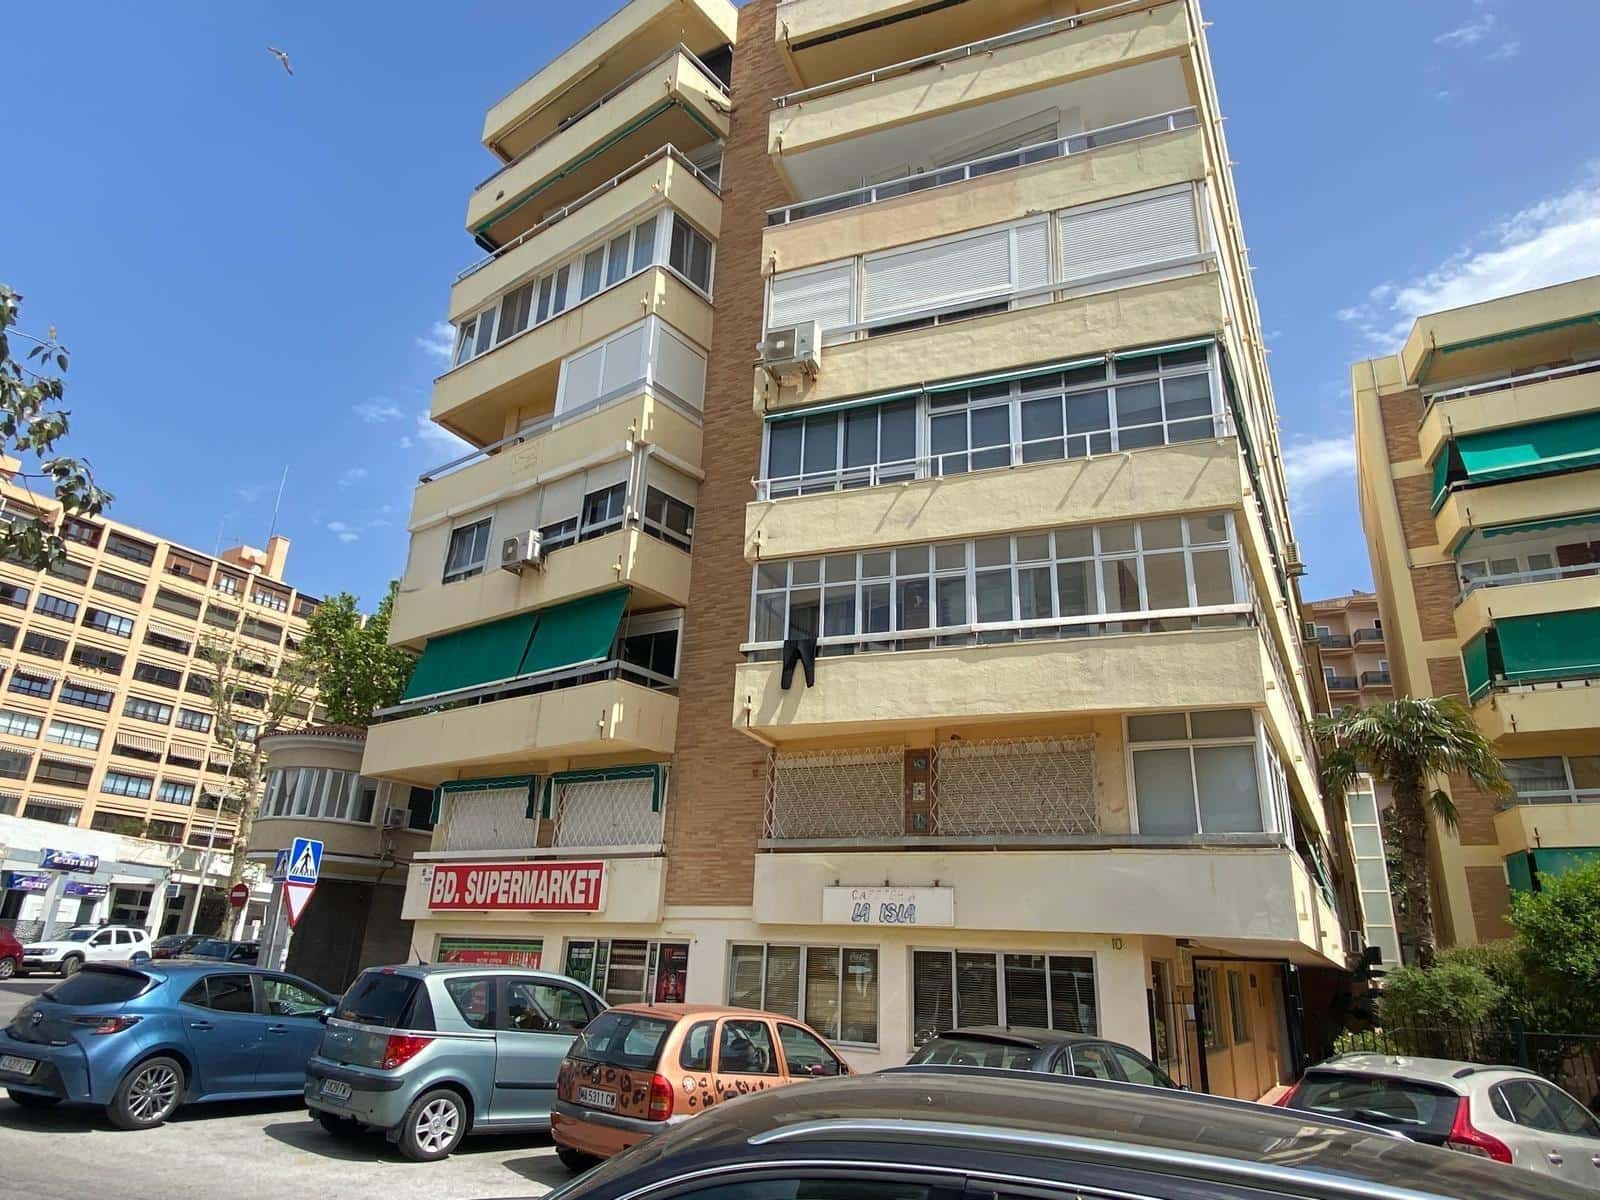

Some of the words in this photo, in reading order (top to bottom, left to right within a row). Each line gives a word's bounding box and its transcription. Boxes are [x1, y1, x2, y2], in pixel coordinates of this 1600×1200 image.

[432, 871, 460, 904] BD.
[464, 869, 601, 905] SUPERMARKET
[852, 902, 871, 922] LA
[879, 903, 916, 923] ISLA
